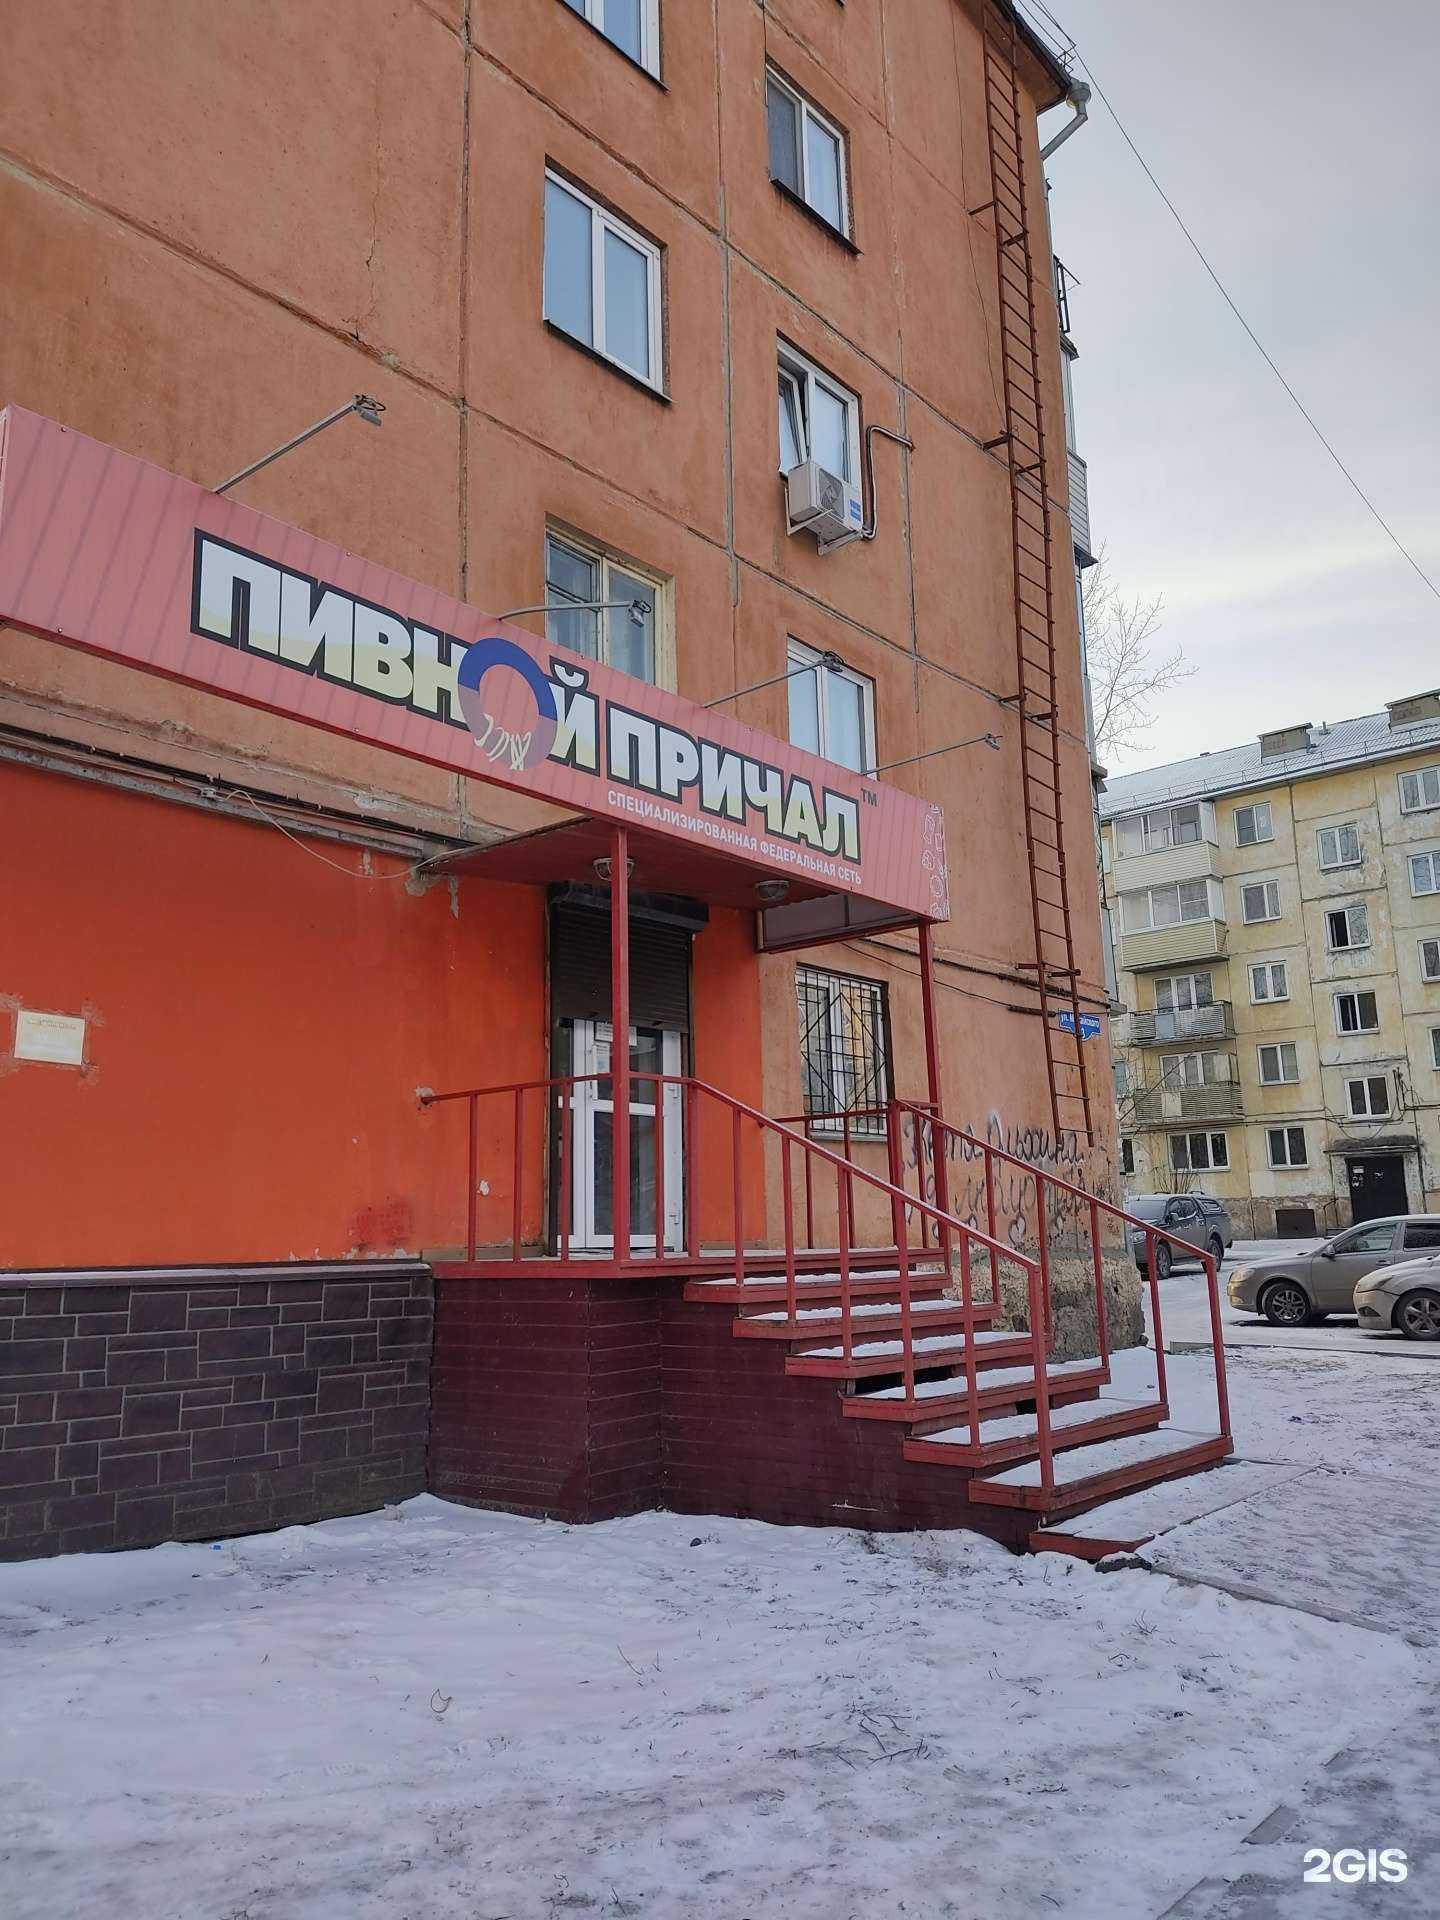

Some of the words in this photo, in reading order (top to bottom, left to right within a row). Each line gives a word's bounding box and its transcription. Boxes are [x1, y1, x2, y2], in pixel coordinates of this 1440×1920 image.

[192, 529, 600, 776] ПИВНОЙ
[607, 701, 861, 865] ПРИЧАЛ
[608, 790, 757, 851] СПЕЦИАЛИЗИРОВАННАЯ
[760, 841, 836, 878] ФЕДЕРАЛЬНАЯ
[837, 865, 862, 885] СЕТЬ
